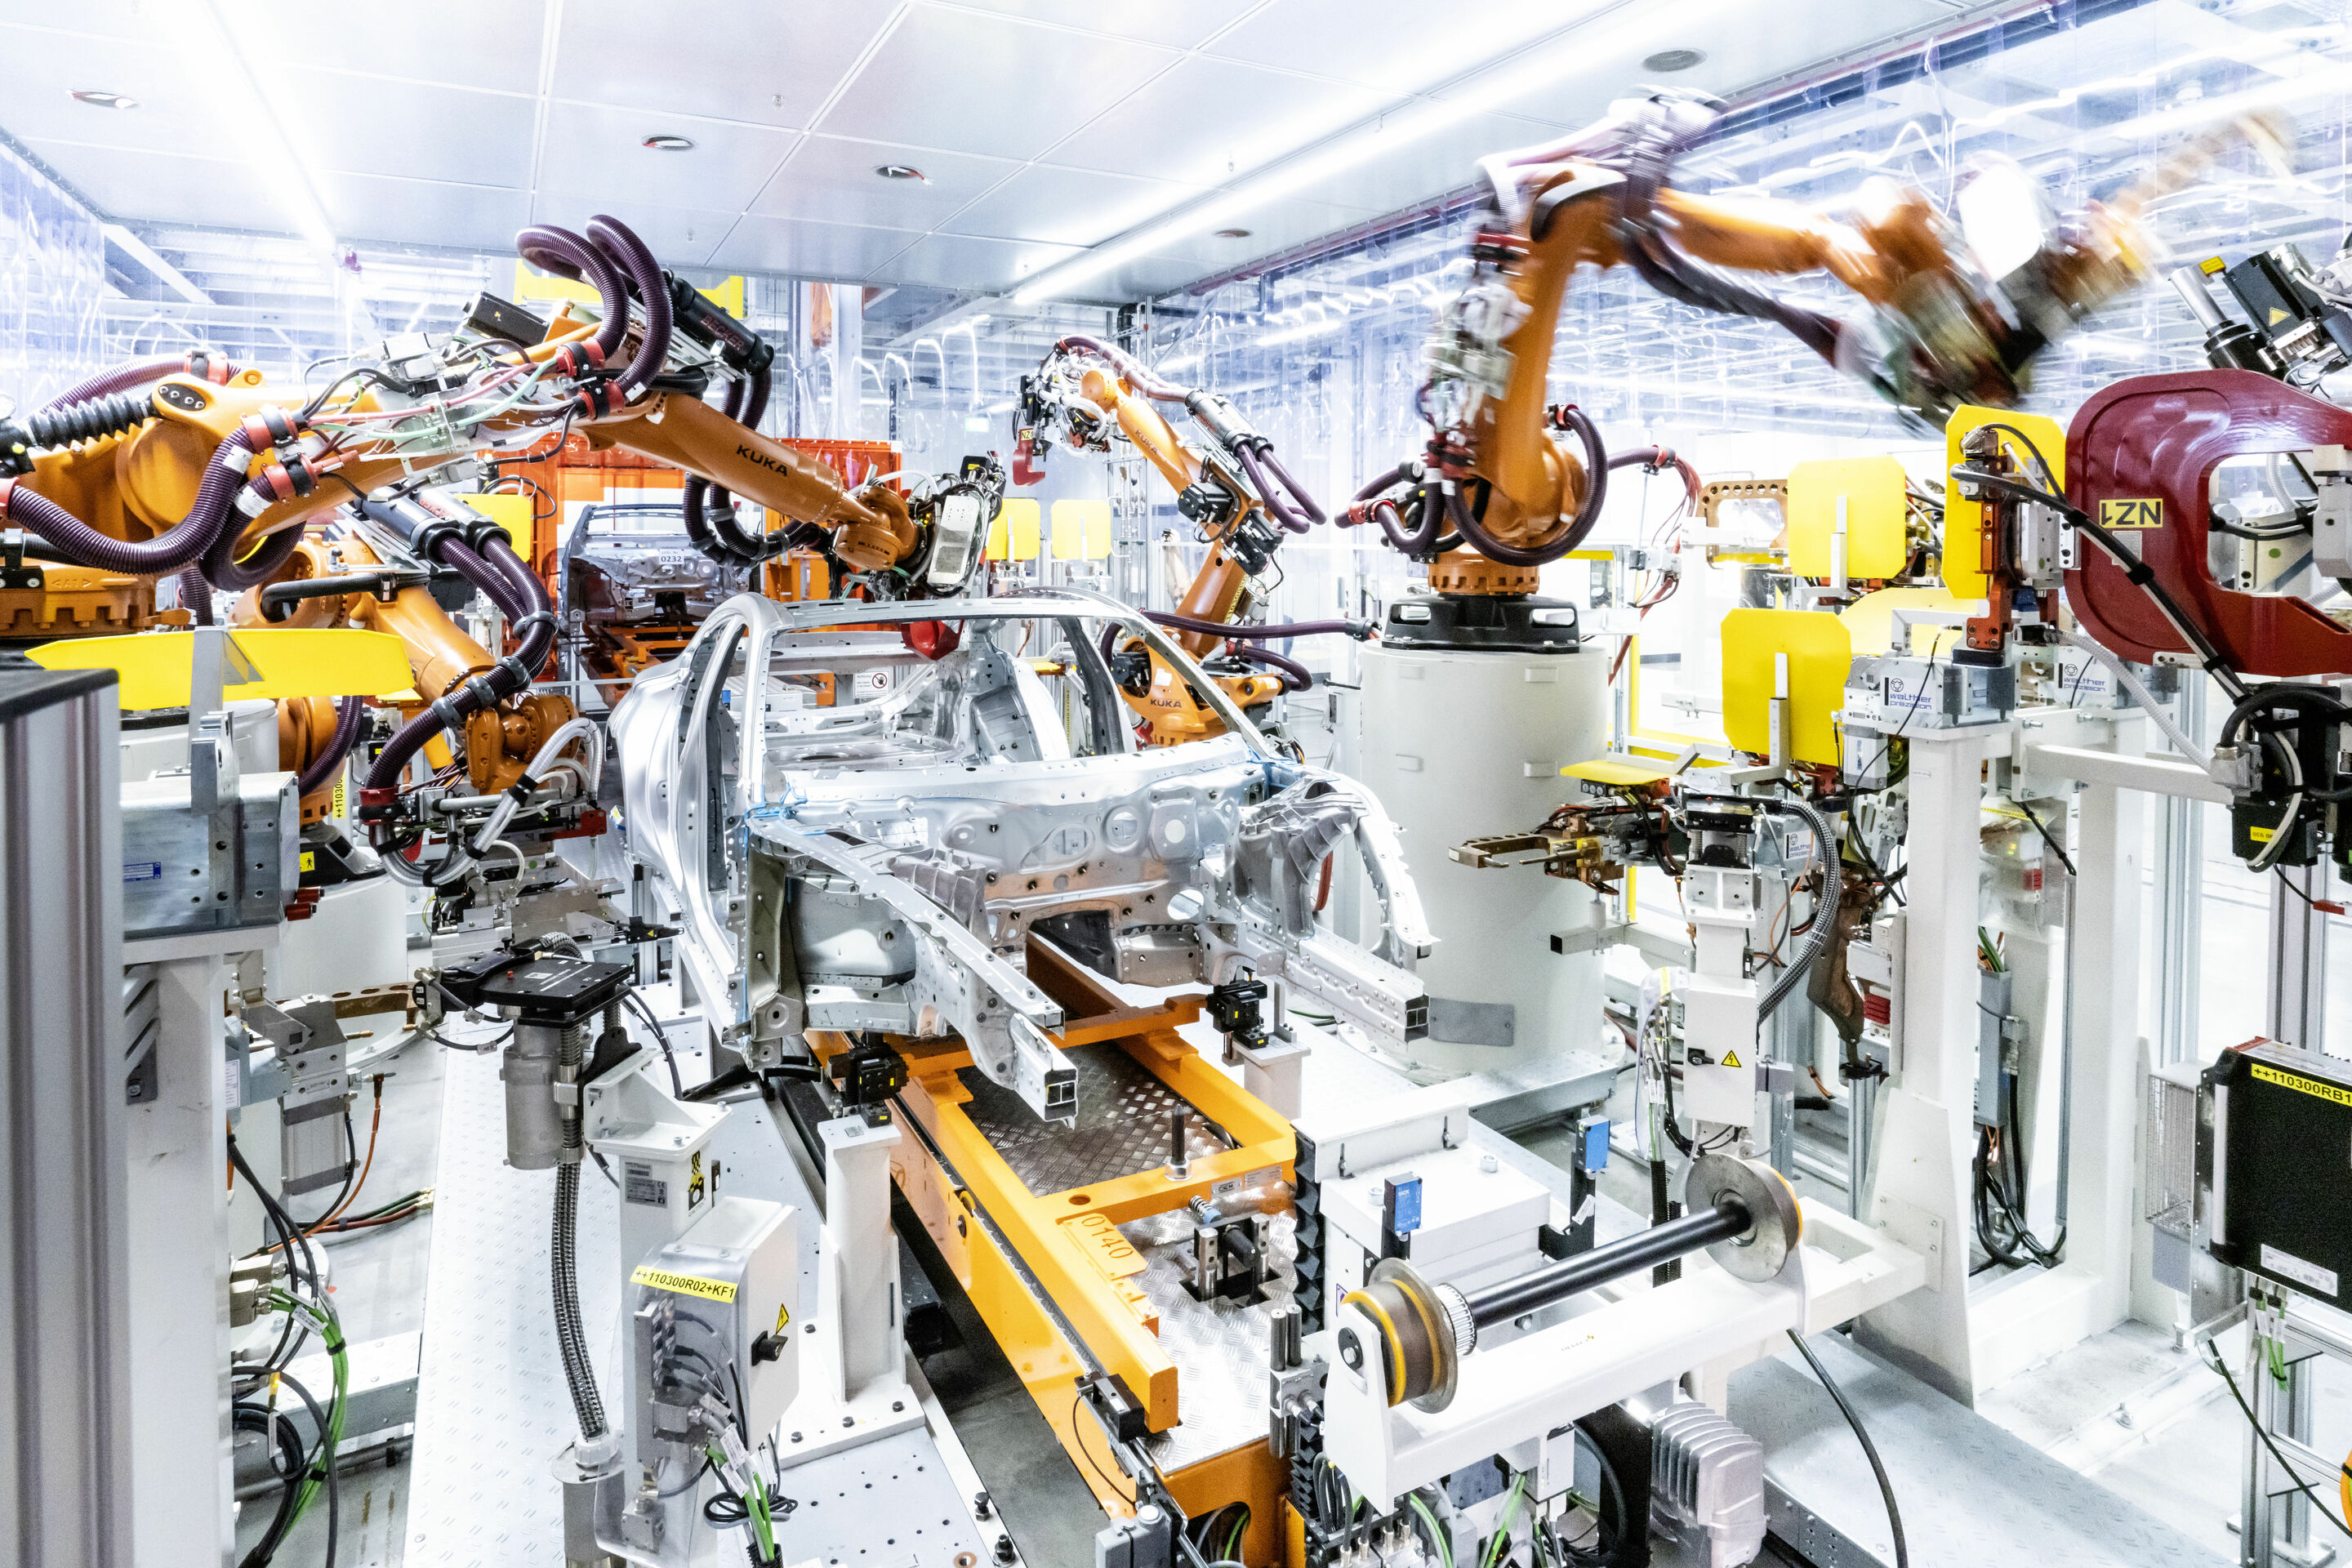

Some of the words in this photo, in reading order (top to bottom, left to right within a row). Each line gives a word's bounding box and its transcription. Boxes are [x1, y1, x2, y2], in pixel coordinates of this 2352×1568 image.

[1021, 430, 1033, 439] NZ
[1135, 429, 1158, 455] KUKA
[736, 444, 788, 477] KUKA
[2100, 501, 2162, 525] NZ1
[1150, 698, 1183, 708] KUKA
[2254, 1067, 2351, 1104] ++110300RB1
[1080, 1216, 1134, 1258] 0140
[635, 1271, 735, 1298] ++110300R02+KF1
